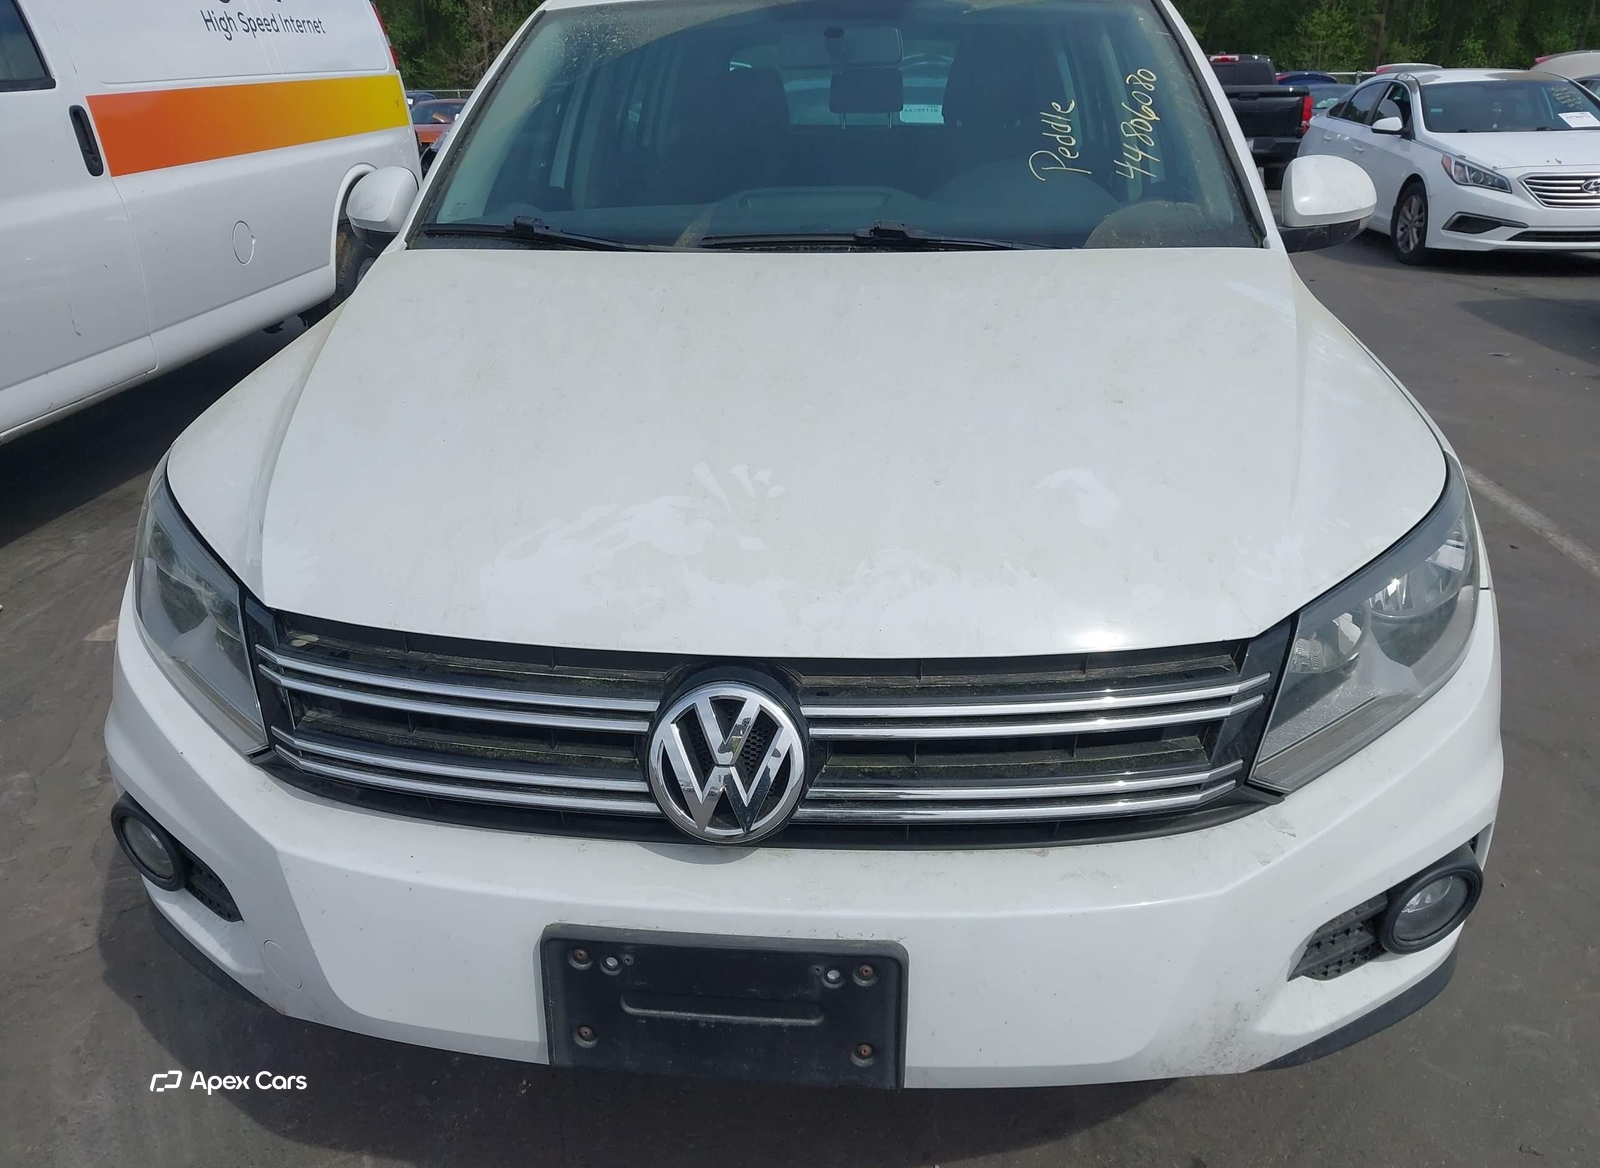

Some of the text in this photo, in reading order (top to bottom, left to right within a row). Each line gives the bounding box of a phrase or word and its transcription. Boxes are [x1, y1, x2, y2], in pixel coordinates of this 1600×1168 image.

[200, 9, 326, 41] High Speed Internet
[1028, 99, 1092, 181] Peddle
[650, 684, 804, 842] VW
